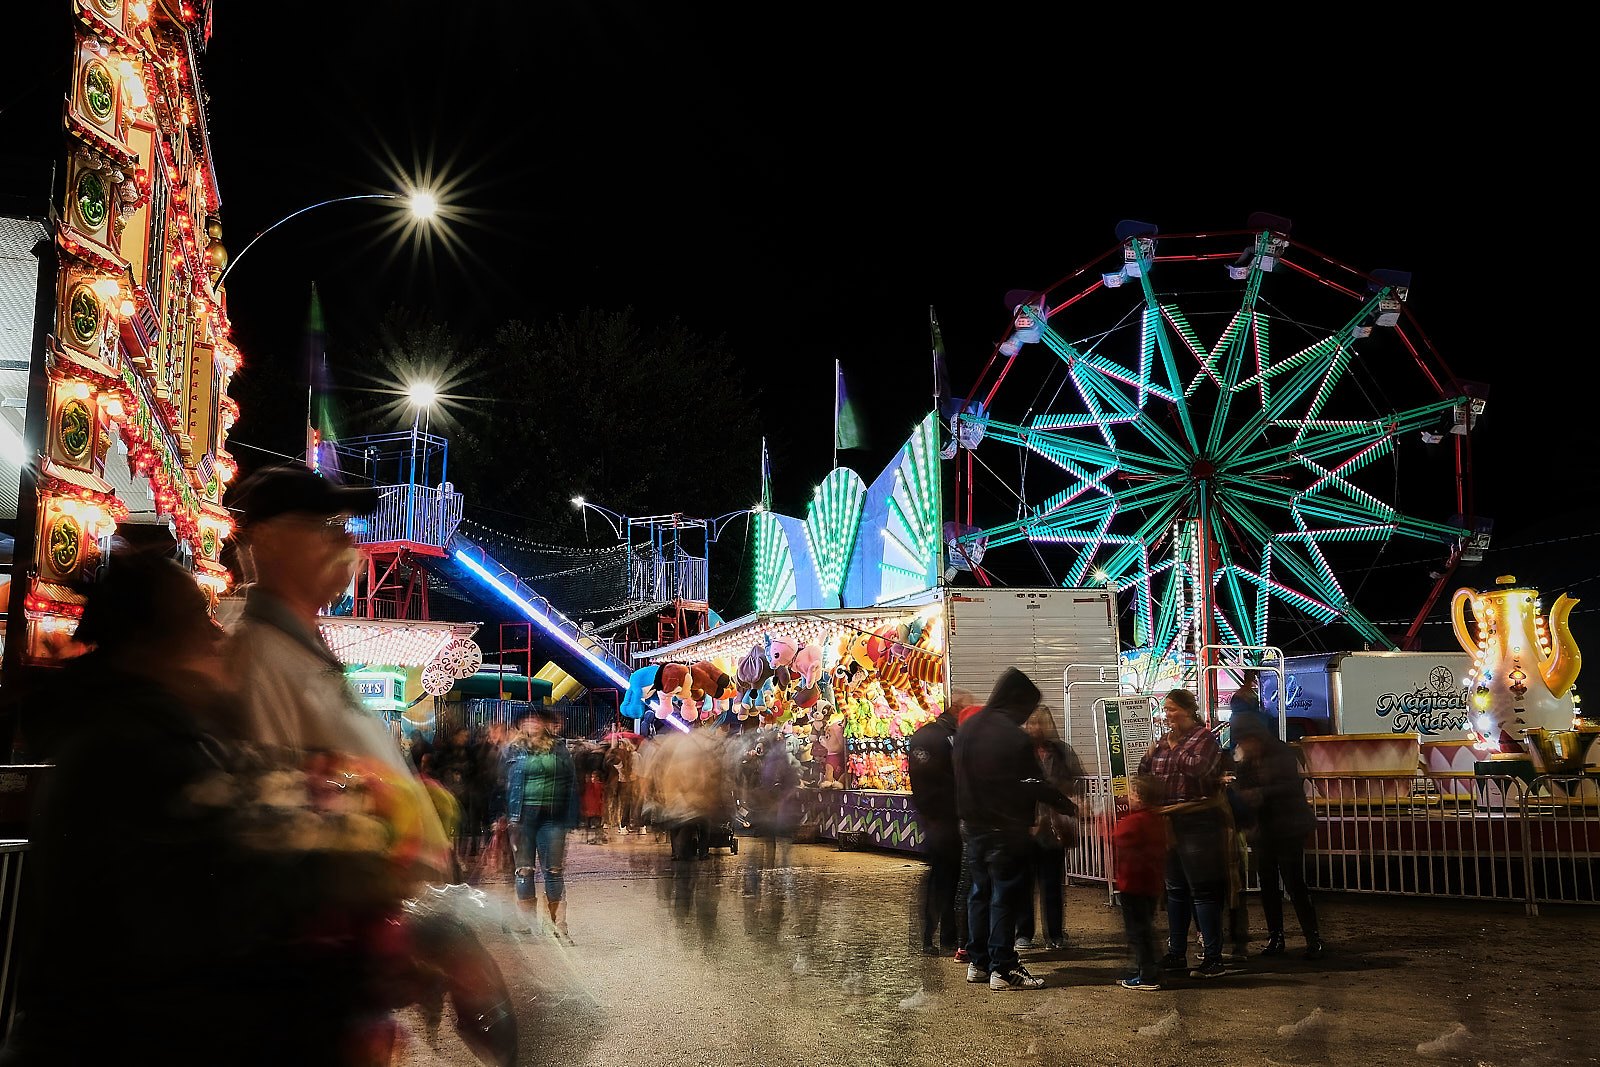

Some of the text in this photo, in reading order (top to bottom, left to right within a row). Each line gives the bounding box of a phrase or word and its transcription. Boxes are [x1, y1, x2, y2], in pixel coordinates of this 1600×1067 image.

[445, 638, 477, 652] WATER
[441, 657, 480, 677] GUN FUN
[422, 678, 453, 694] GUN FUN
[1375, 687, 1468, 717] Magical
[1130, 710, 1139, 718] 2
[1391, 711, 1467, 735] Midw
[1108, 725, 1121, 754] YES
[1116, 804, 1129, 812] NO
